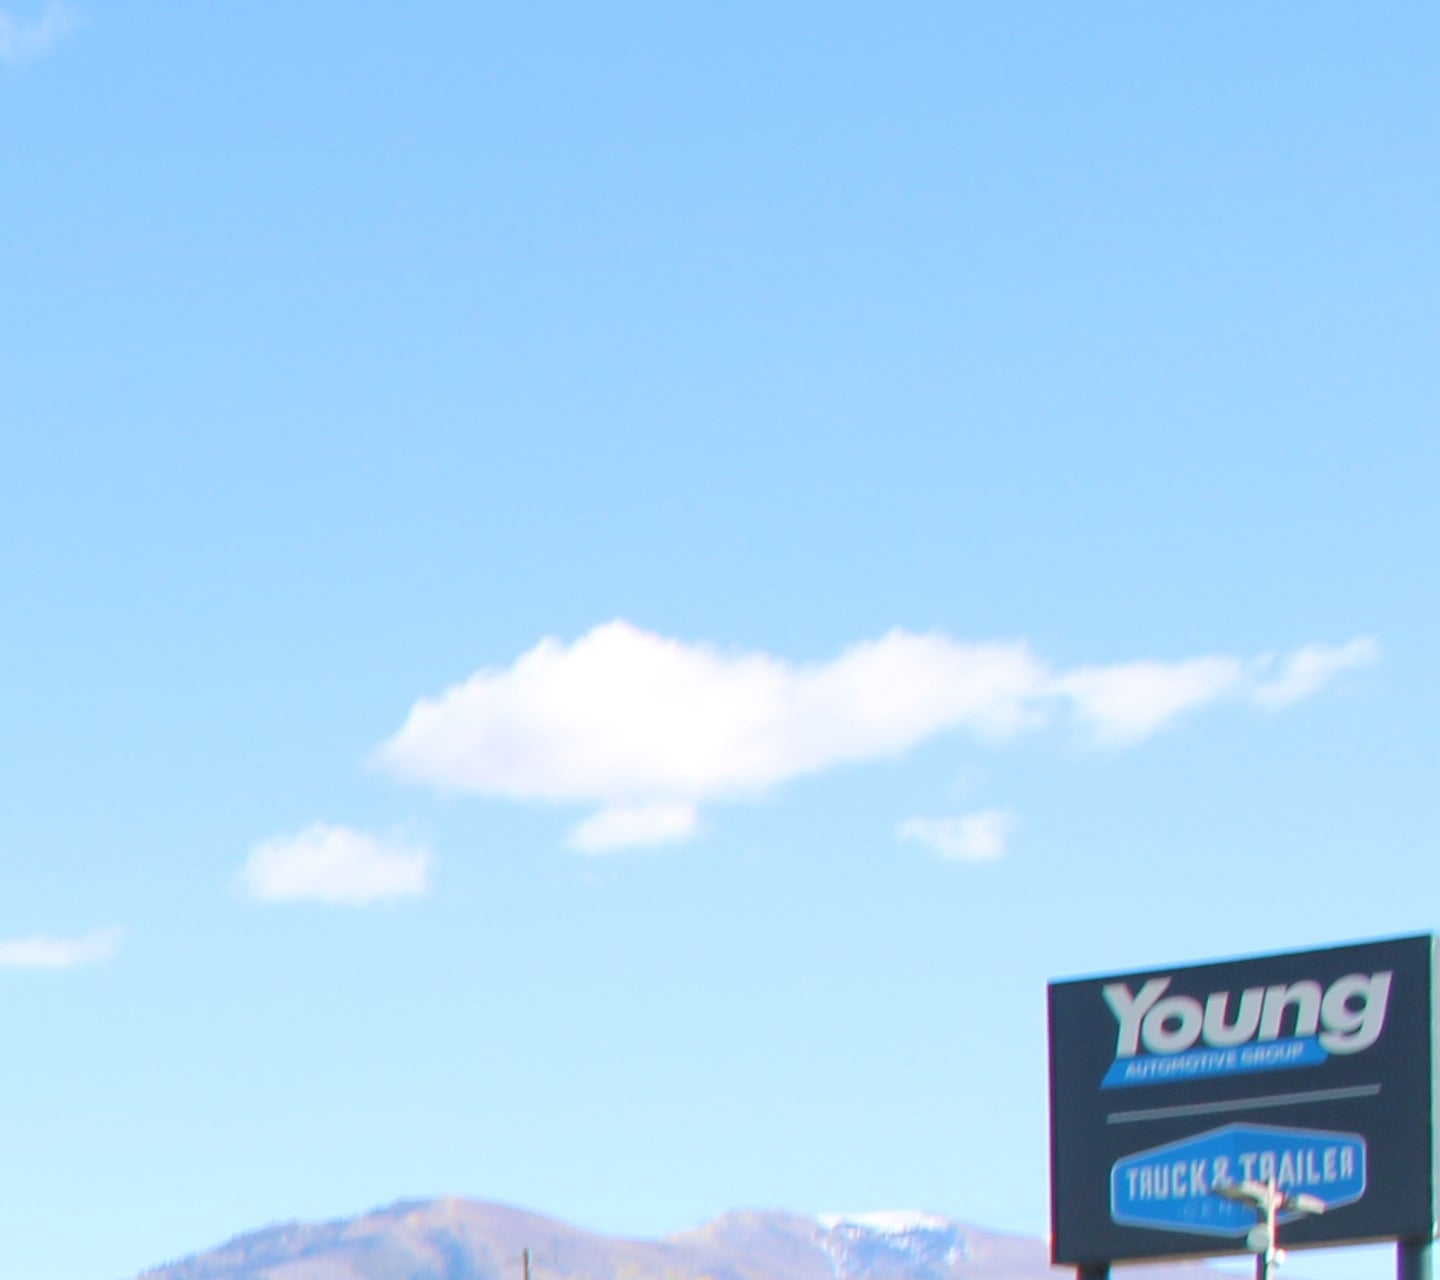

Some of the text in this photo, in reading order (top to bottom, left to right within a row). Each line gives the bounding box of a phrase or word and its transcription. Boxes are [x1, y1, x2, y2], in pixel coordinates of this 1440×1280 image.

[1101, 970, 1394, 1058] Young
[1125, 1042, 1305, 1081] AUTOMOTIVE GROUP
[1126, 1145, 1356, 1201] TRUCK & TRAILER
